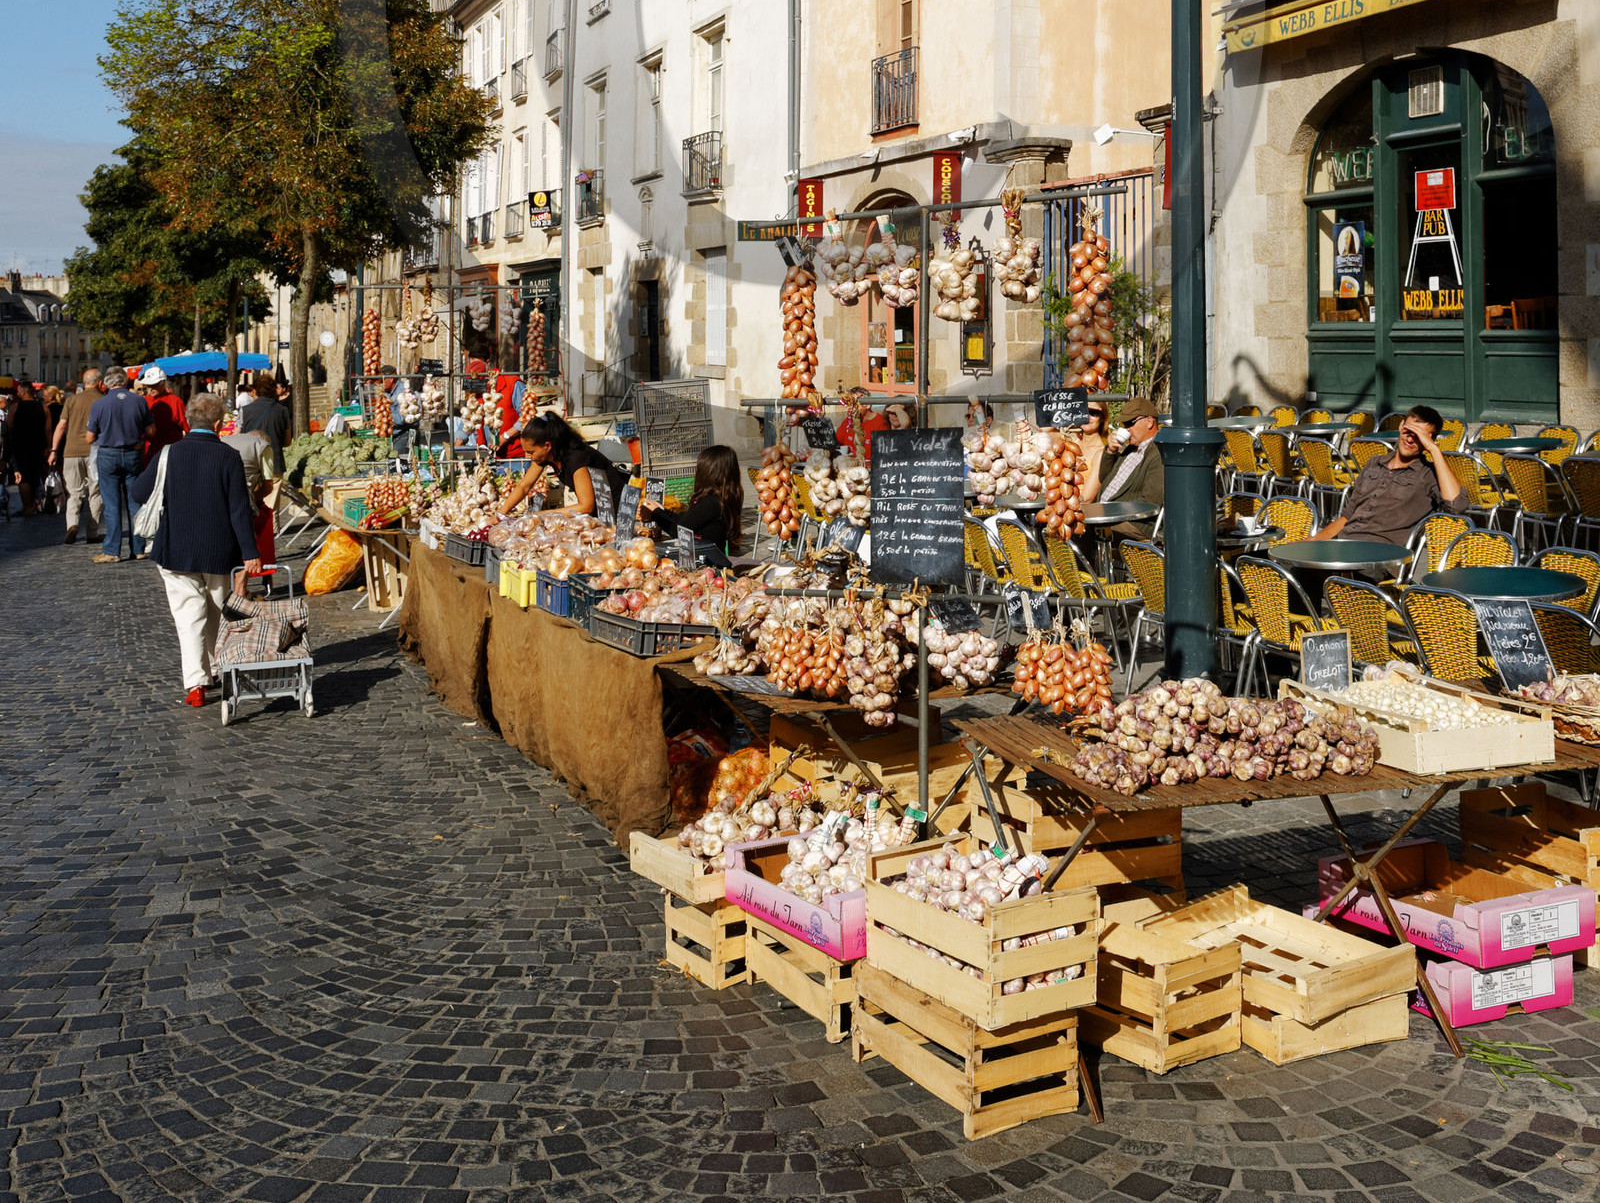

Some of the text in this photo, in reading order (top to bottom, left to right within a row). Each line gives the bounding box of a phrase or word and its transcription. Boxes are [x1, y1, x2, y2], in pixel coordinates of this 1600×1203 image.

[1279, 10, 1316, 36] WEBB
[941, 158, 952, 205] COUSCO
[806, 185, 815, 232] TAGINS
[1424, 209, 1444, 223] BAR
[760, 225, 799, 239] KHALIF
[1423, 221, 1446, 236] PUB
[1403, 290, 1433, 311] WEBB
[736, 884, 803, 932] Ail rose du Tarn
[1360, 910, 1380, 923] rose
[1400, 912, 1428, 940] Tarn
